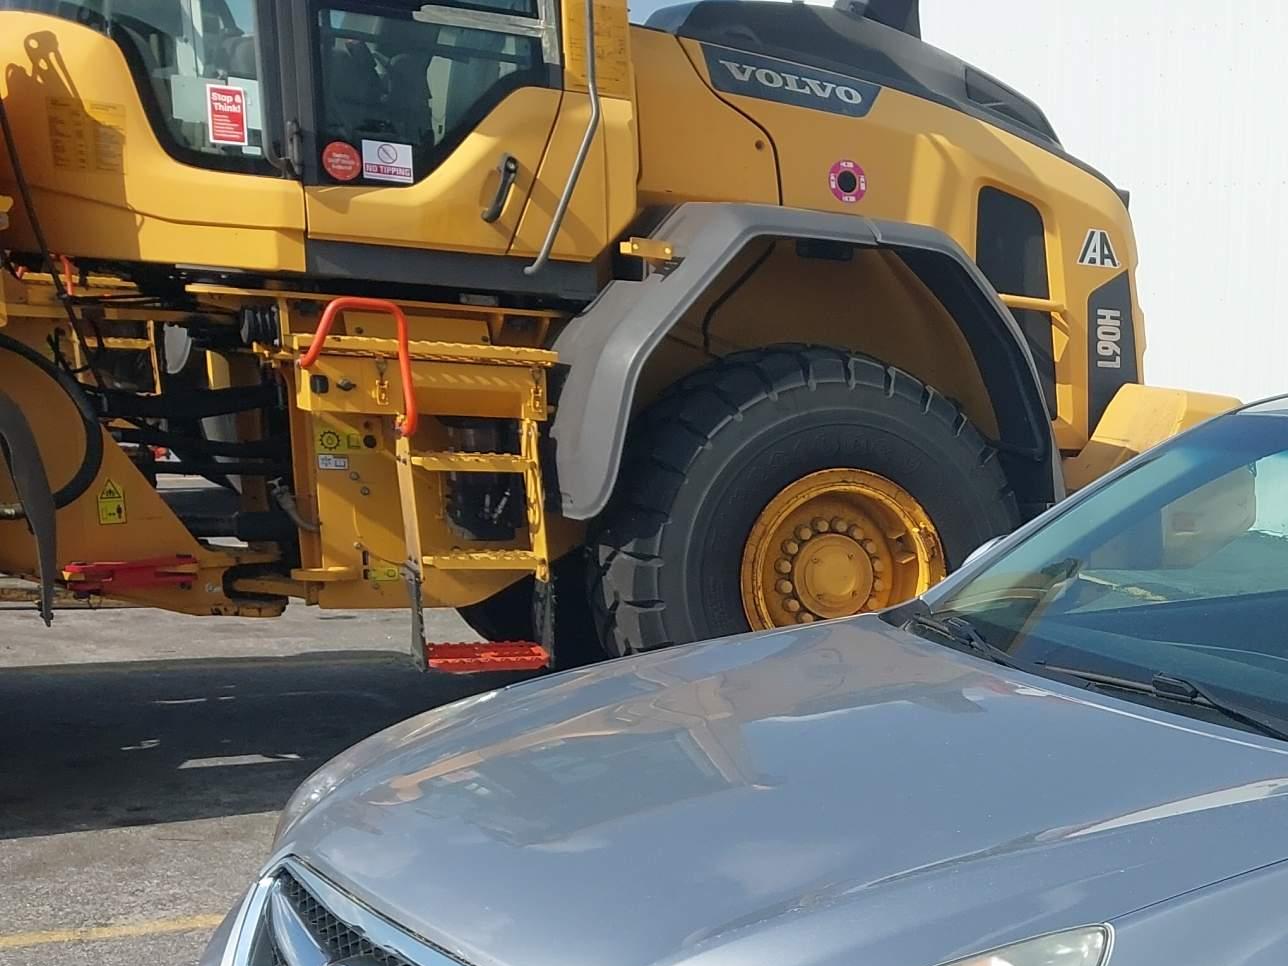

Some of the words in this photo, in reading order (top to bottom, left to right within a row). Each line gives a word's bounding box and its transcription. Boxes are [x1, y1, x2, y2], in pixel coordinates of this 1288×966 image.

[719, 60, 862, 104] VOLVO
[211, 91, 234, 104] Stop
[365, 163, 378, 173] NO
[379, 165, 411, 177] TIPPING
[1096, 308, 1121, 369] L90H
